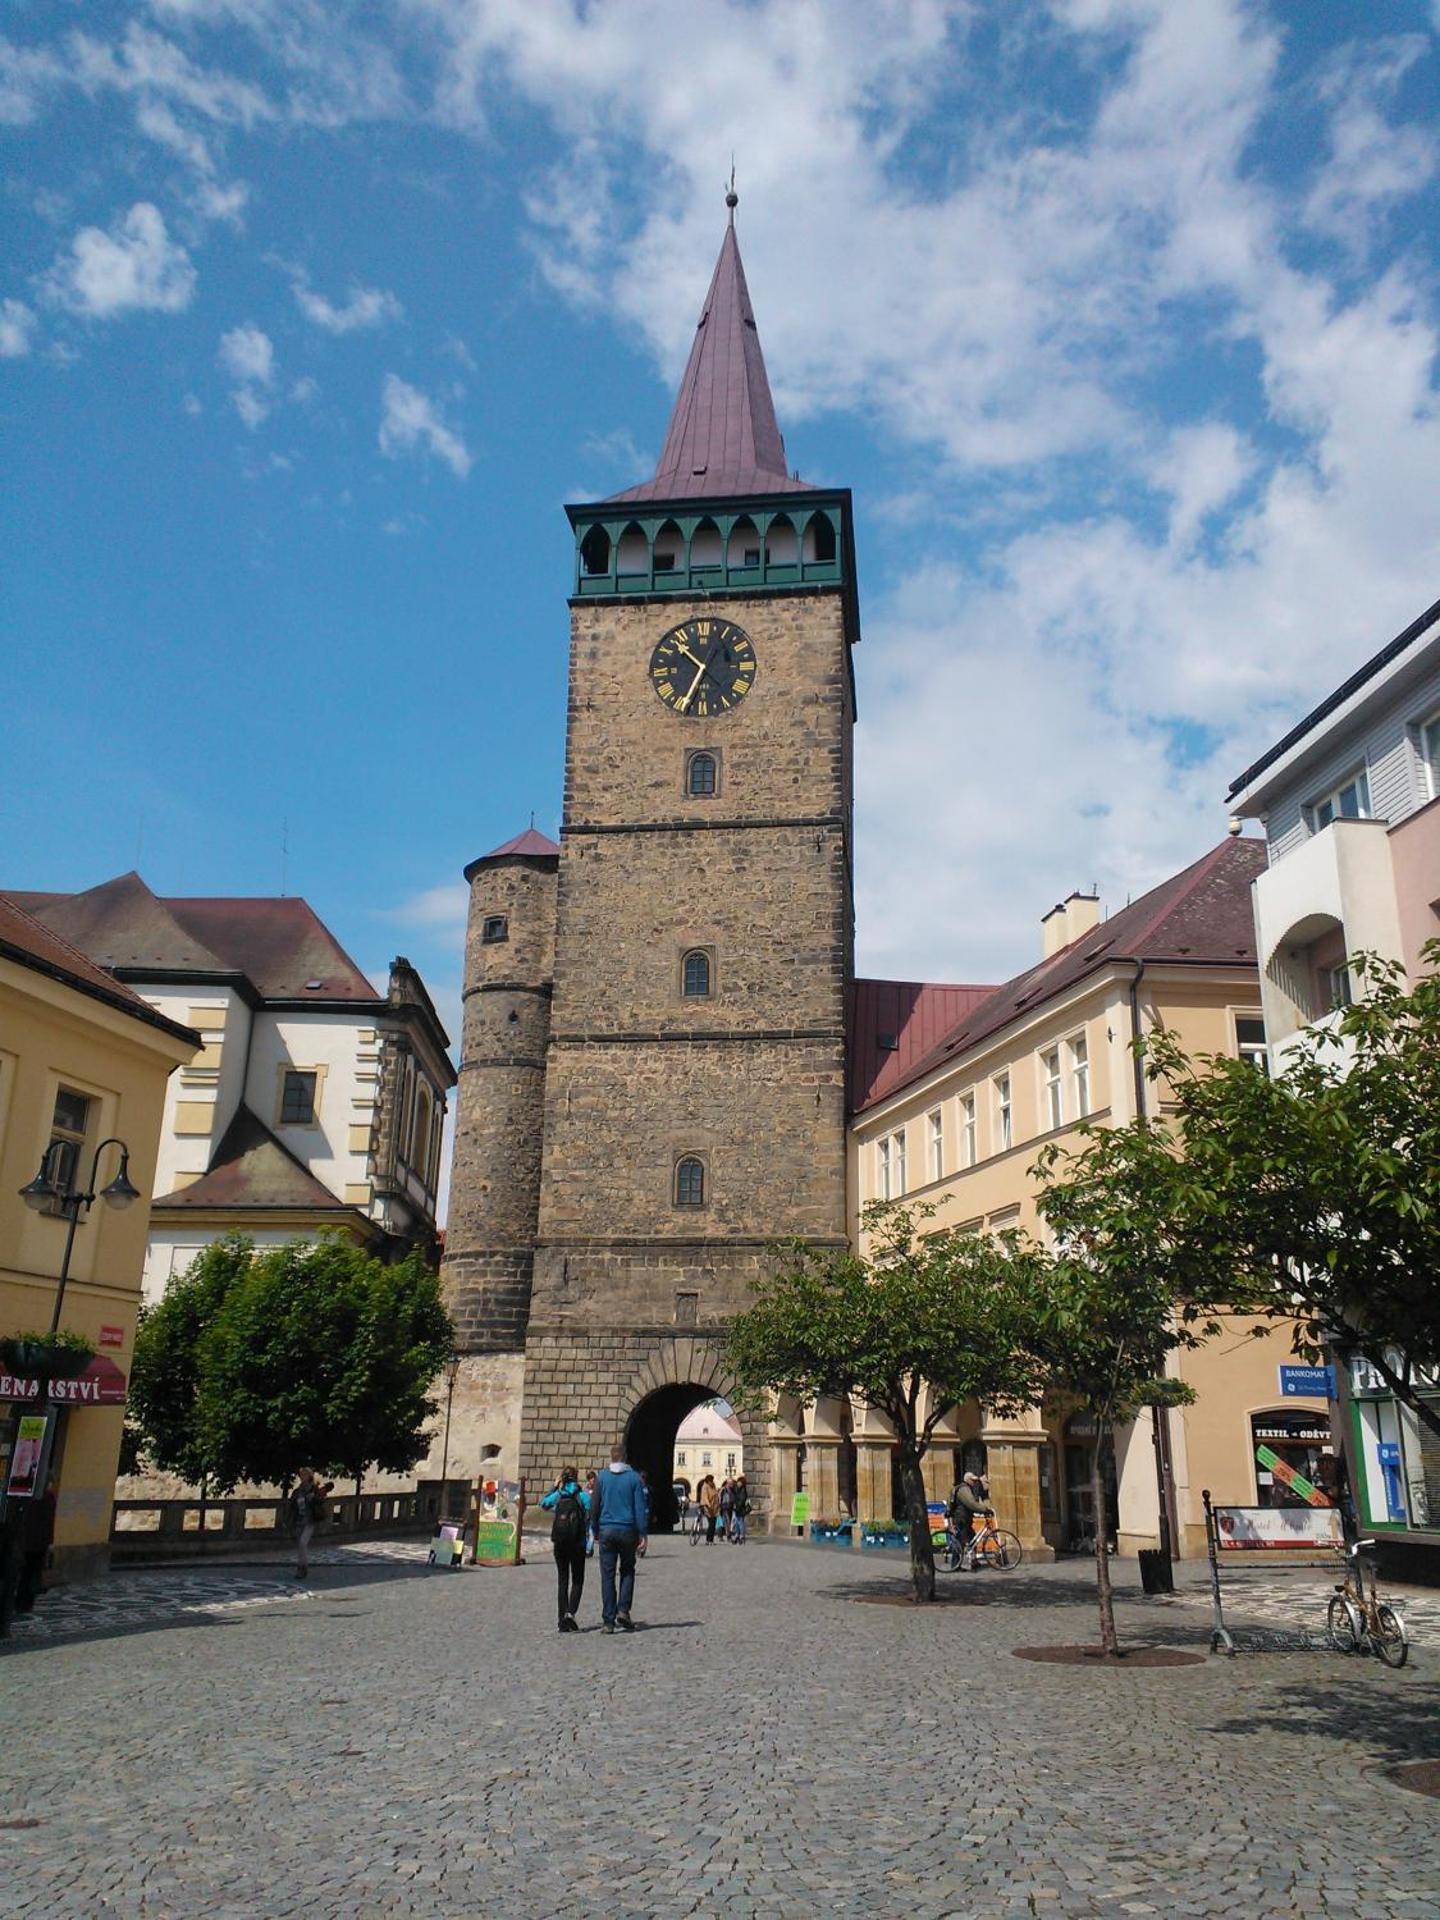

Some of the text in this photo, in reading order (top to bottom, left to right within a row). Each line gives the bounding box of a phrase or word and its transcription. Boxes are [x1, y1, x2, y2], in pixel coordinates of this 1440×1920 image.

[1285, 1369, 1326, 1378] BANKOMAT
[1256, 1429, 1289, 1438] TEXTIL
[1300, 1429, 1332, 1439] ODĚVY
